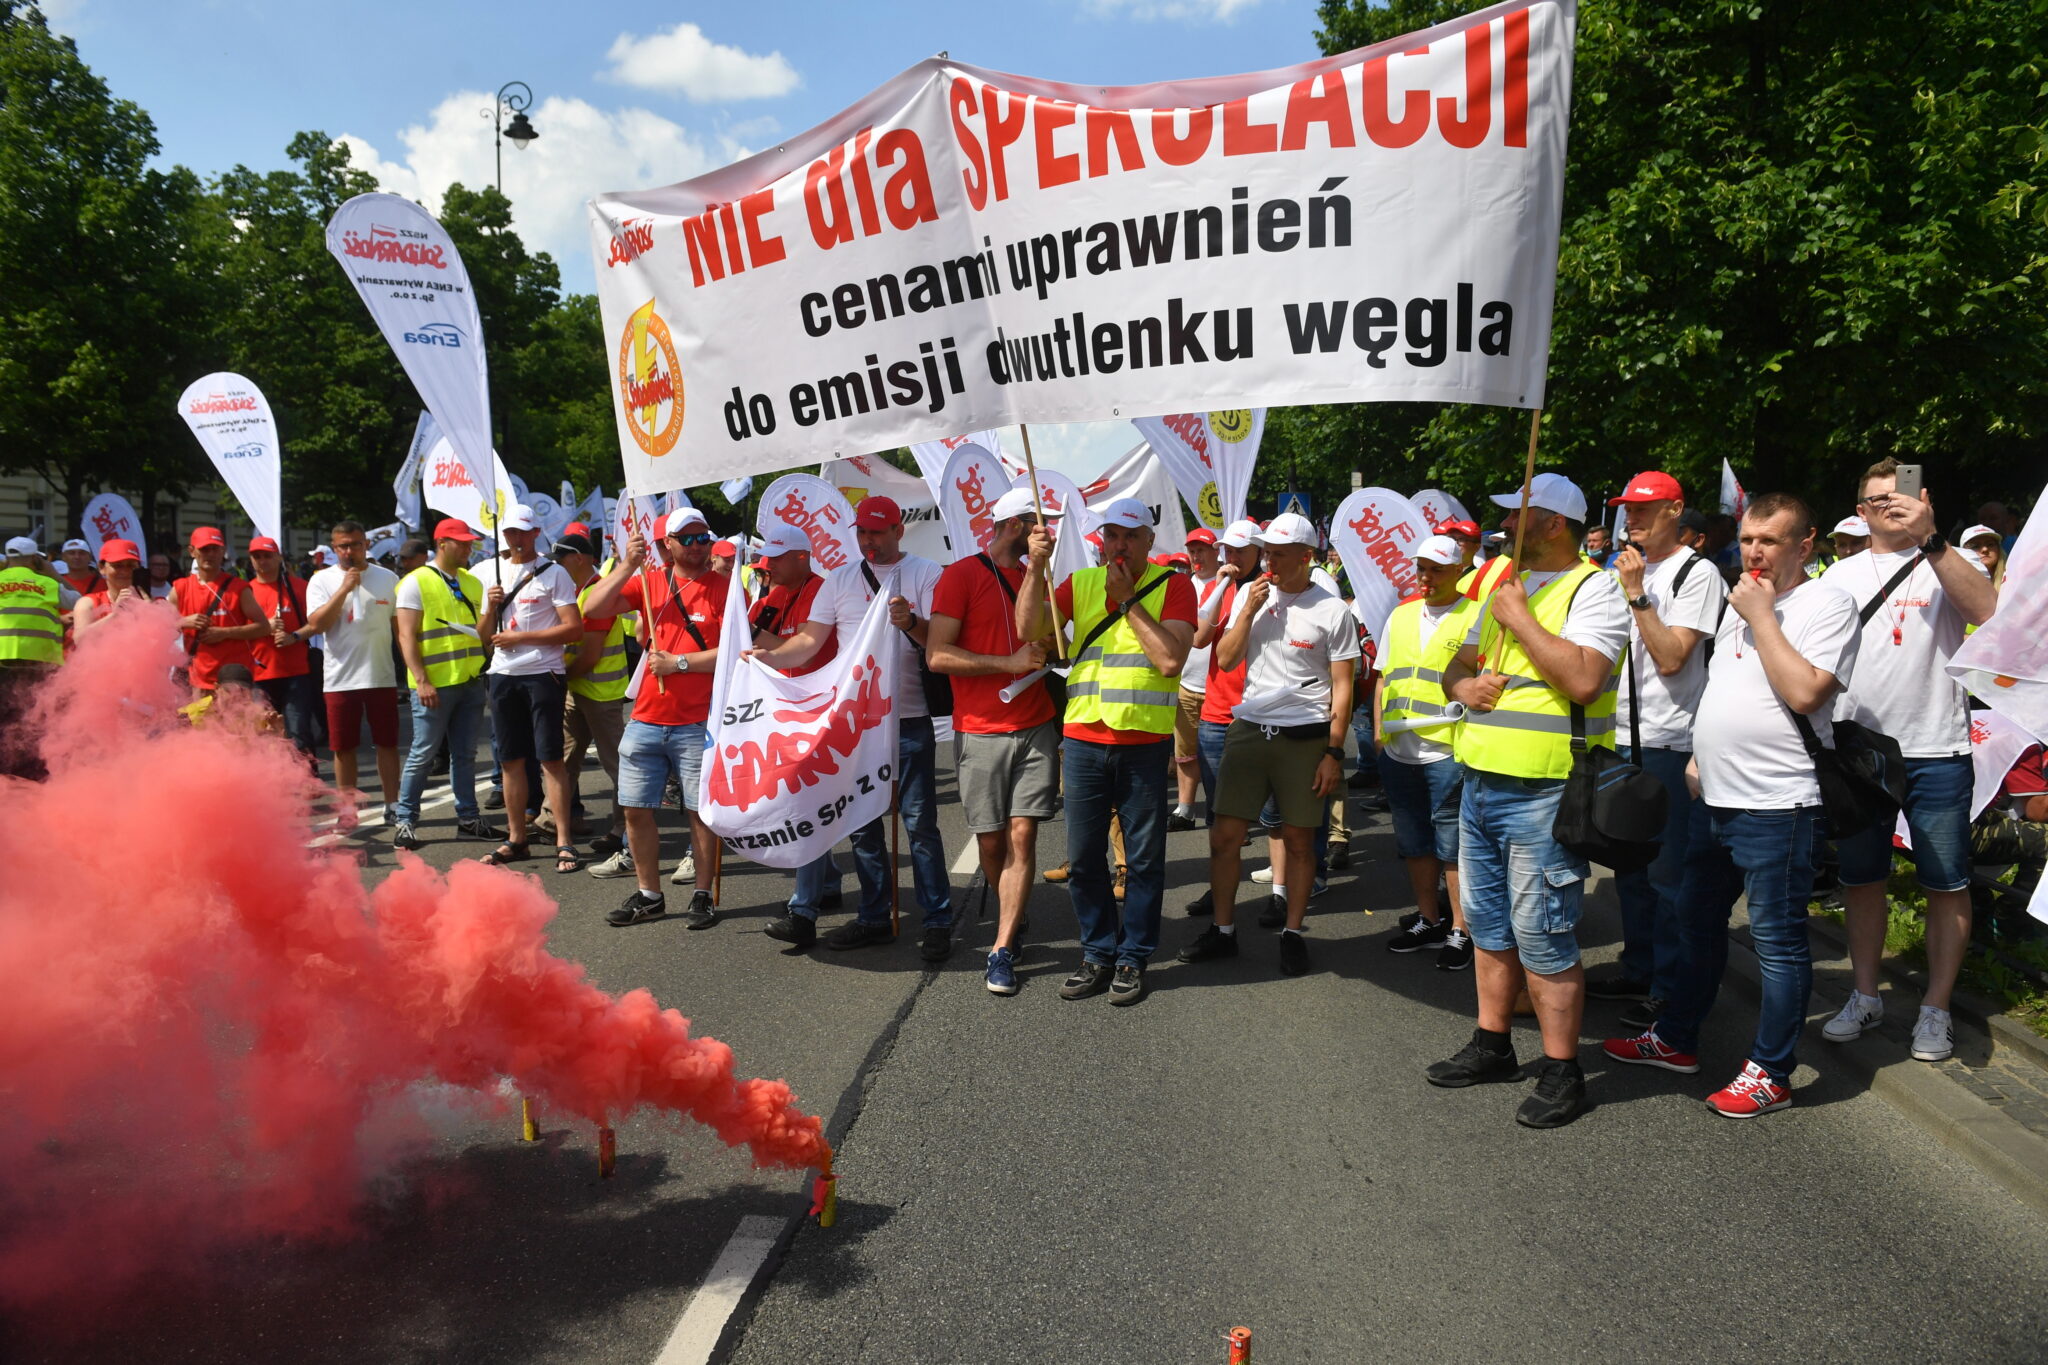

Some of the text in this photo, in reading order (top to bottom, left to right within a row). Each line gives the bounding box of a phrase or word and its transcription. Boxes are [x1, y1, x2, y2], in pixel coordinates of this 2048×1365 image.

[682, 7, 1531, 288] NIE dla SPEKULACJI
[800, 176, 1352, 337] cenami uprawnień
[723, 282, 1515, 441] do emisji dwutlenku węgla
[723, 698, 764, 726] SZZ
[722, 763, 892, 849] arzanie Sp. z o
